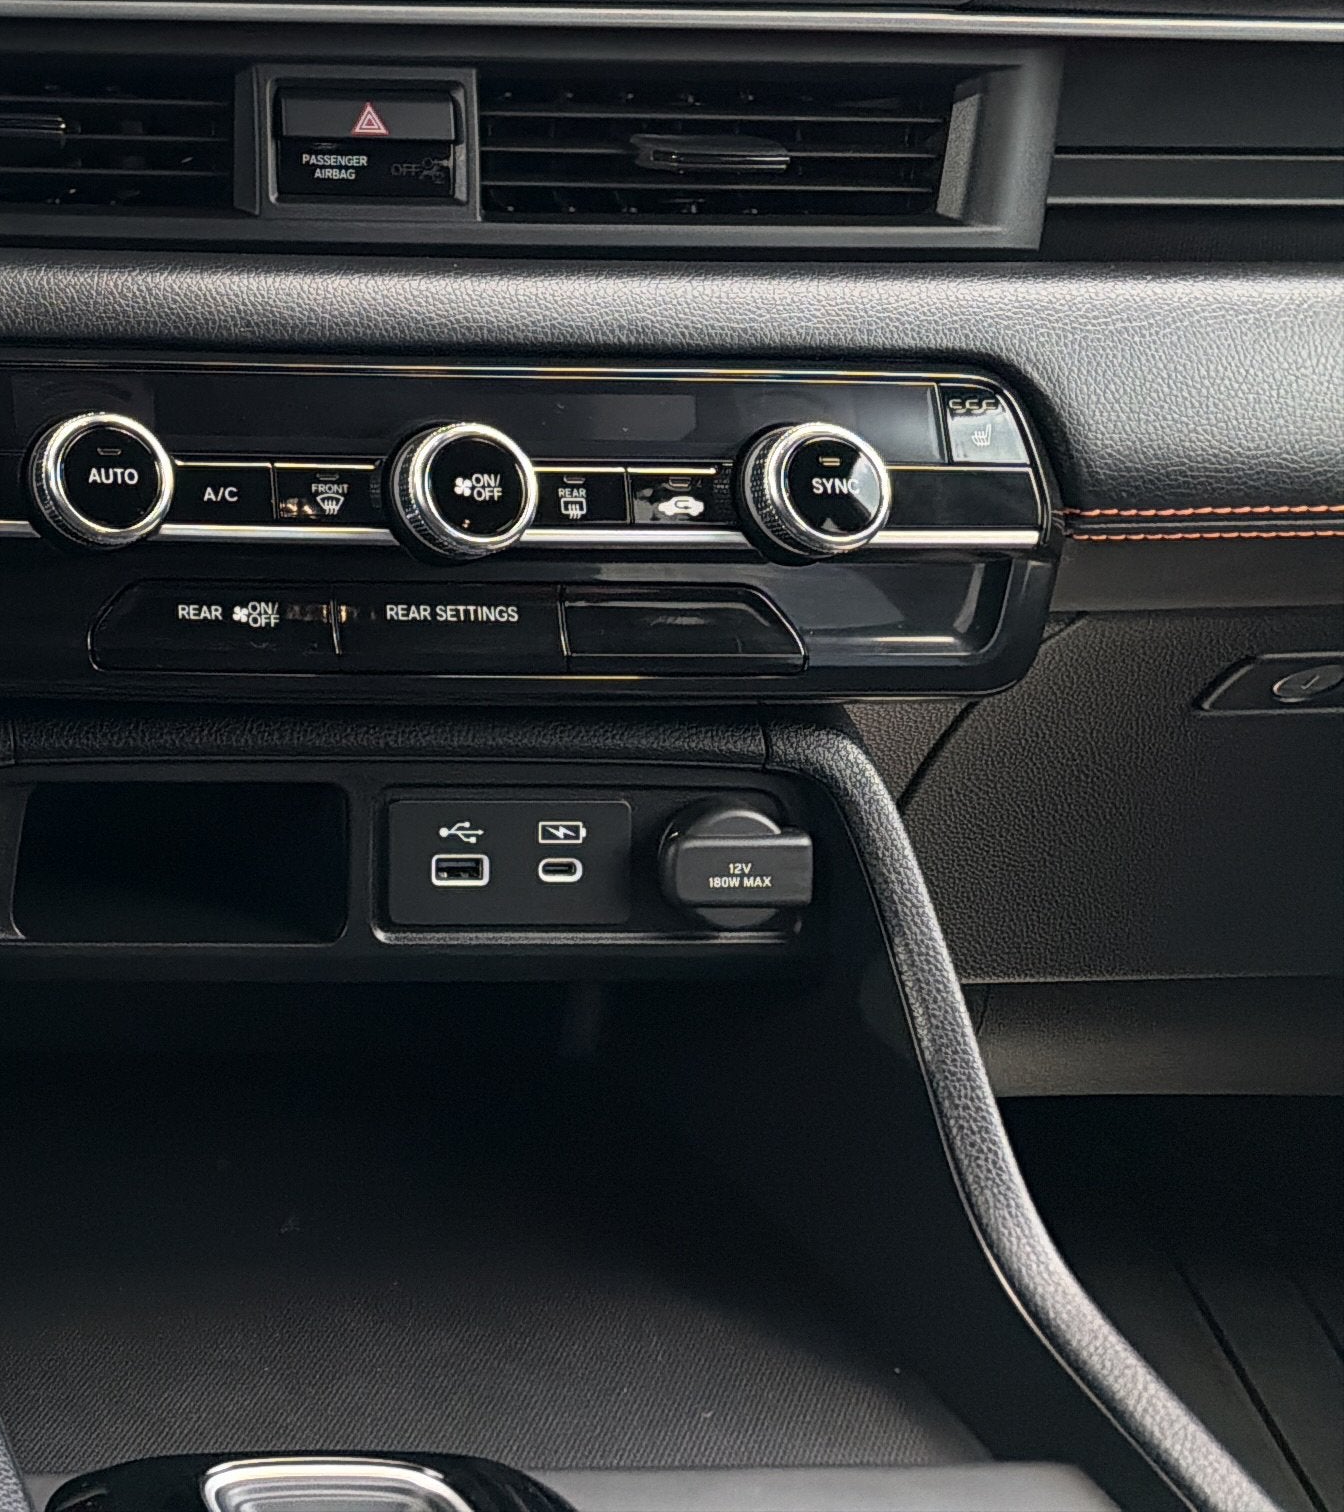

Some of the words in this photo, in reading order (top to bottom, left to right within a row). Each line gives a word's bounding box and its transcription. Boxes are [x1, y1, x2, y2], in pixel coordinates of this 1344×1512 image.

[302, 154, 368, 167] PASSENGER
[314, 168, 356, 180] AIRBAG
[88, 468, 139, 486] AUTO
[472, 473, 501, 487] ON/
[311, 483, 348, 494] FRONT
[811, 477, 861, 495] SYNC
[203, 486, 239, 503] A/C
[473, 488, 502, 501] OFF
[558, 488, 587, 498] REAR
[178, 604, 223, 620] REAR
[386, 605, 432, 621] REAR
[436, 605, 519, 623] SETTINGS
[248, 614, 280, 628] OFF
[728, 862, 752, 875] 12V
[708, 876, 741, 888] 180W
[743, 875, 772, 888] MAX
